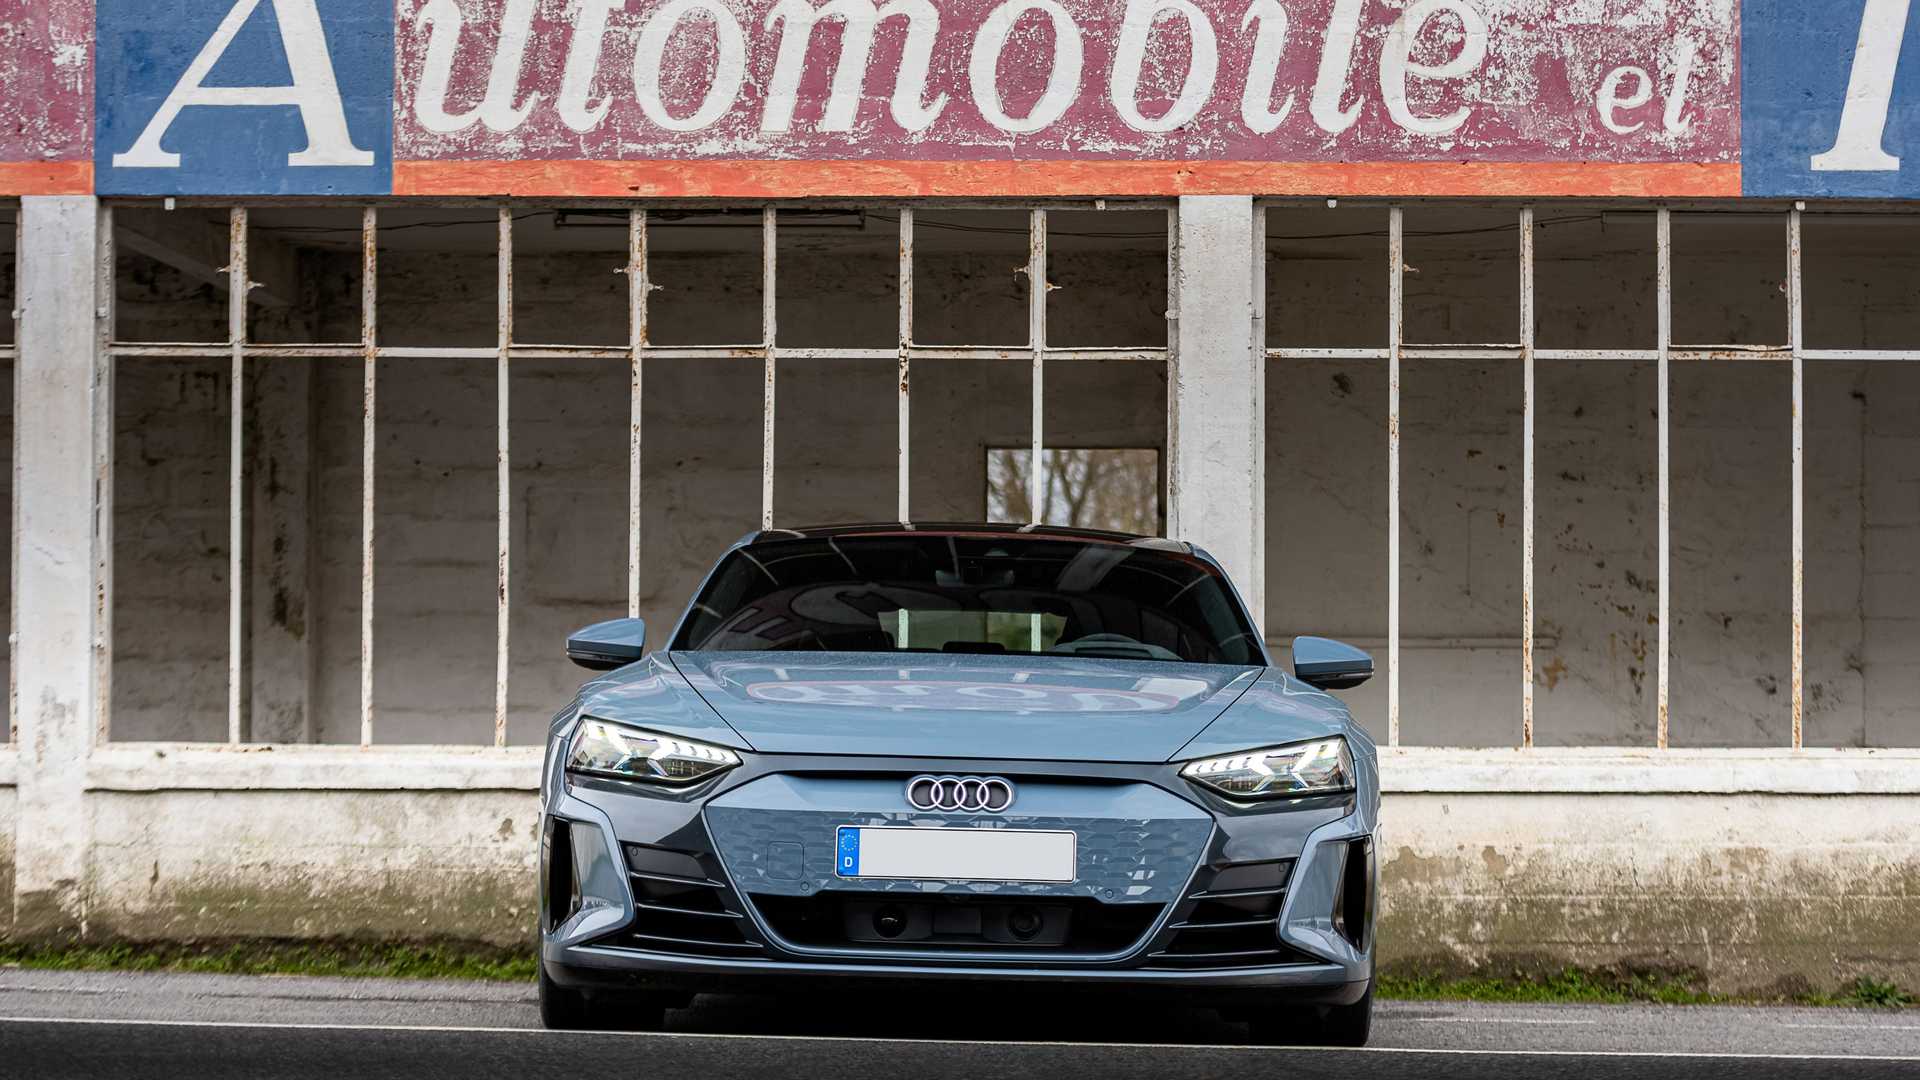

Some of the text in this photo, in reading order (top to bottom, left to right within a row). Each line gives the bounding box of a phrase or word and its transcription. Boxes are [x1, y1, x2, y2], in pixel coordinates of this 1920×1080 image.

[112, 0, 1489, 168] Automobile
[1595, 32, 1698, 136] et
[844, 856, 853, 868] D
